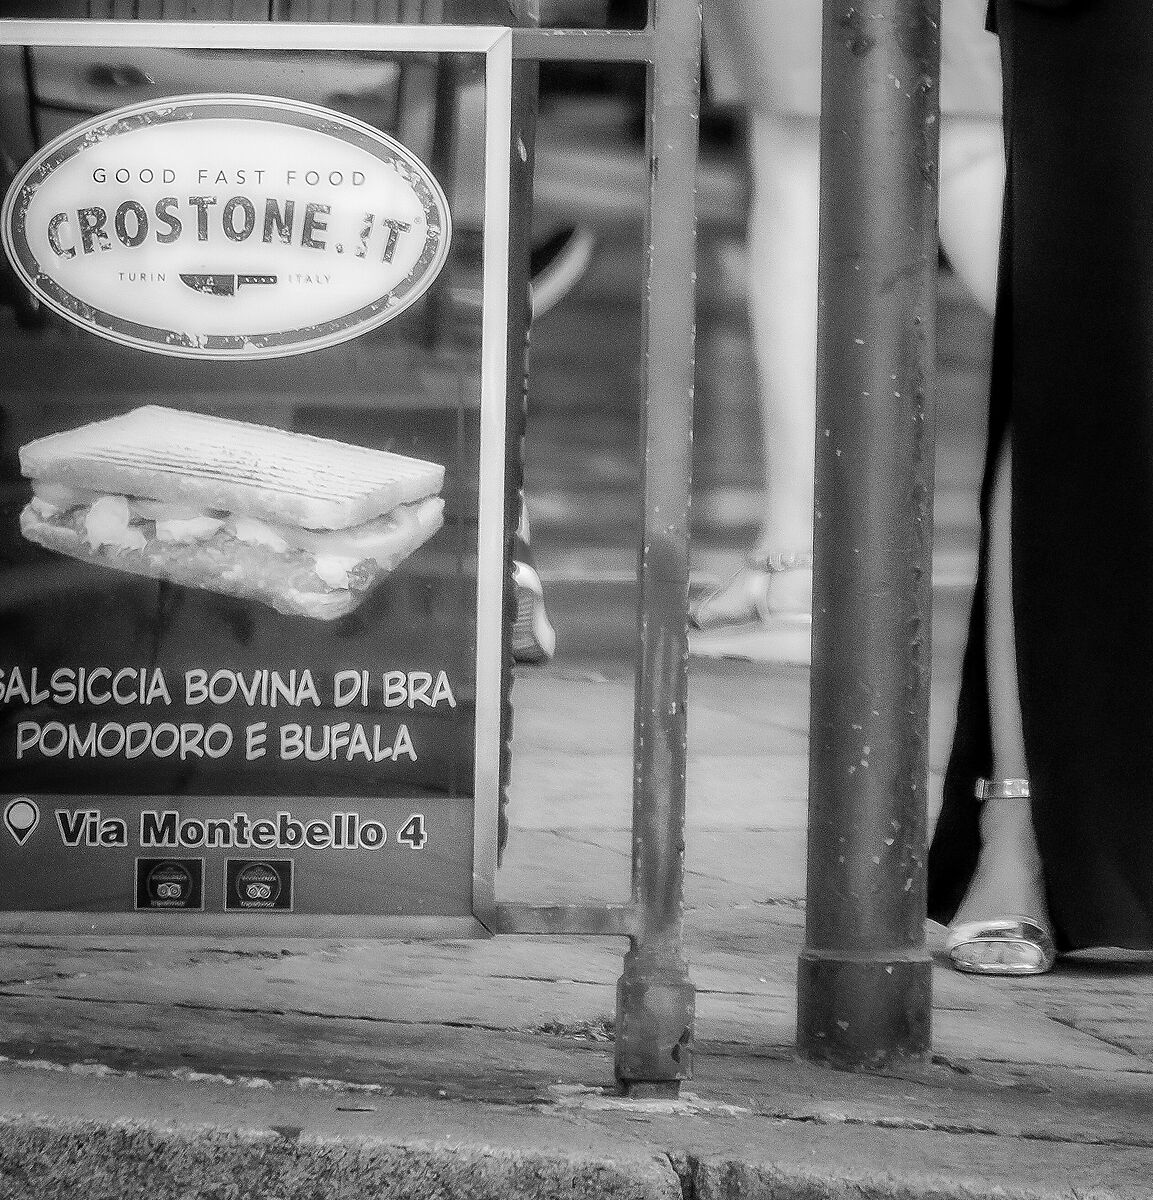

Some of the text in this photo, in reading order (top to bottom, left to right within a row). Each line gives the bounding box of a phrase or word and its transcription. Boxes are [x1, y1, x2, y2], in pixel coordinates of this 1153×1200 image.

[92, 168, 367, 186] GOOD FAST FOOD
[118, 272, 167, 283] TURIN
[288, 274, 332, 284] ITALY
[0, 666, 457, 709] ALSICCIA BOVINA DI BRA
[17, 721, 418, 762] POMODORO E BUFALA
[55, 809, 428, 850] Via Montebello 4
